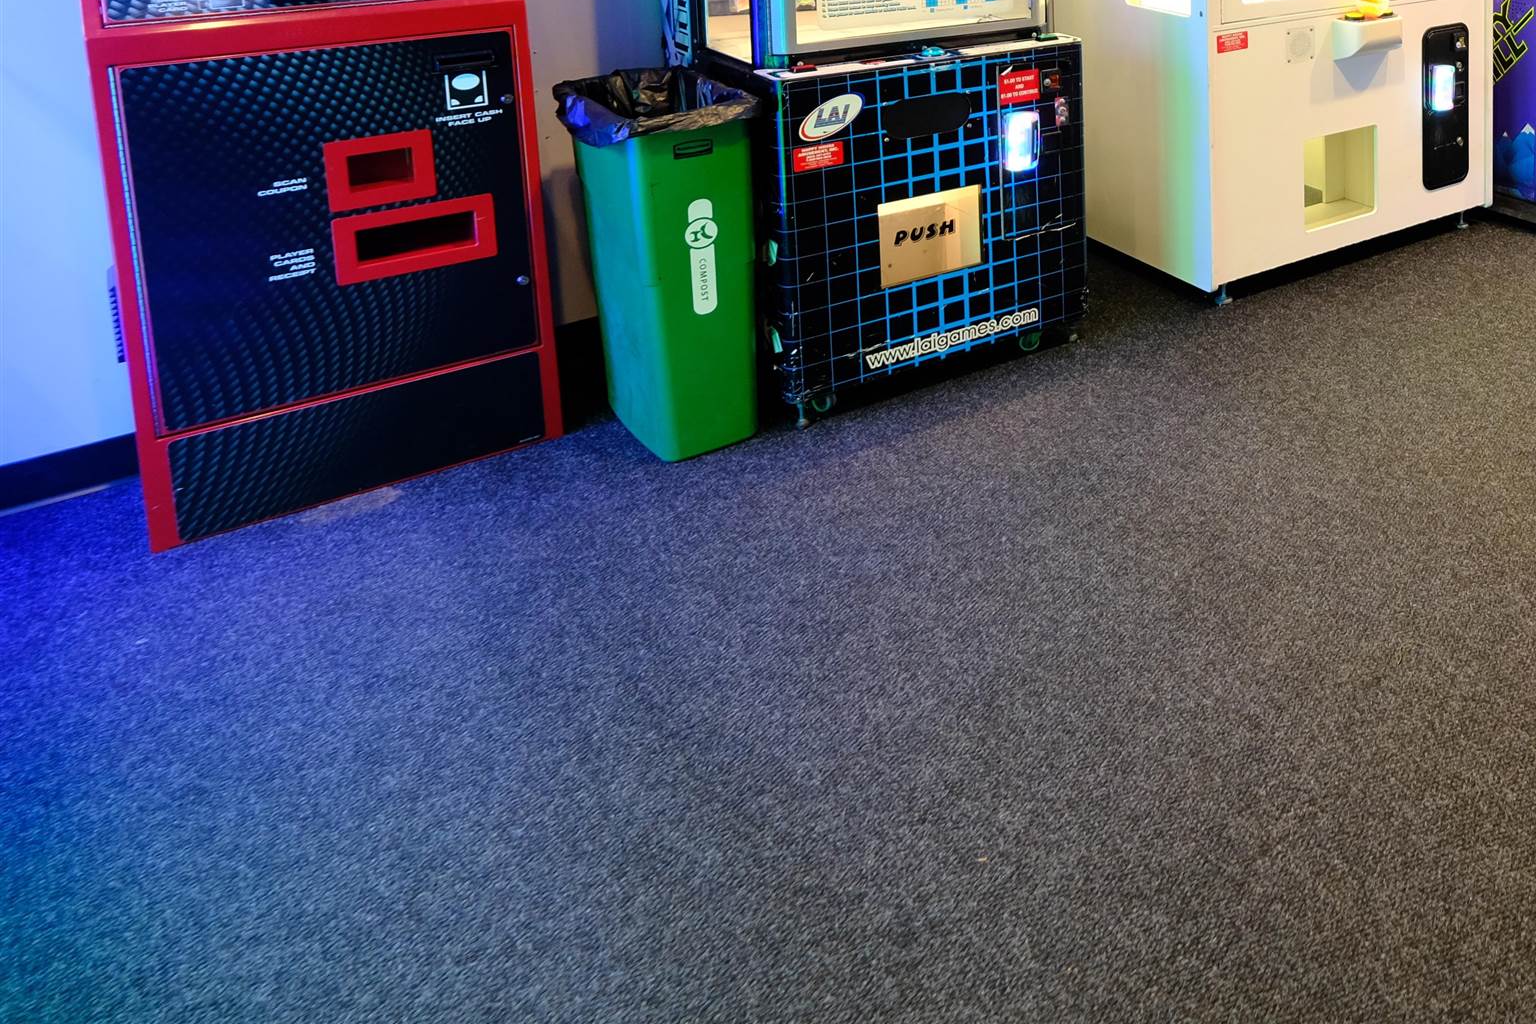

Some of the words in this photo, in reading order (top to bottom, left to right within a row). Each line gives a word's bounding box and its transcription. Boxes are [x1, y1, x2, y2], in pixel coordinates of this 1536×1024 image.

[435, 113, 472, 123] INSERT
[474, 109, 503, 117] CASH
[448, 118, 475, 127] FACE
[814, 104, 850, 128] LAI
[273, 177, 308, 187] SCAN
[257, 184, 308, 196] COUPON
[893, 219, 956, 247] PUSH
[270, 248, 314, 261] PLAYER
[273, 255, 315, 267] CARDS
[289, 261, 316, 271] AND
[268, 267, 317, 282] RECEIPT
[699, 258, 709, 301] COMPOST
[866, 308, 1039, 369] www.laigames.com
